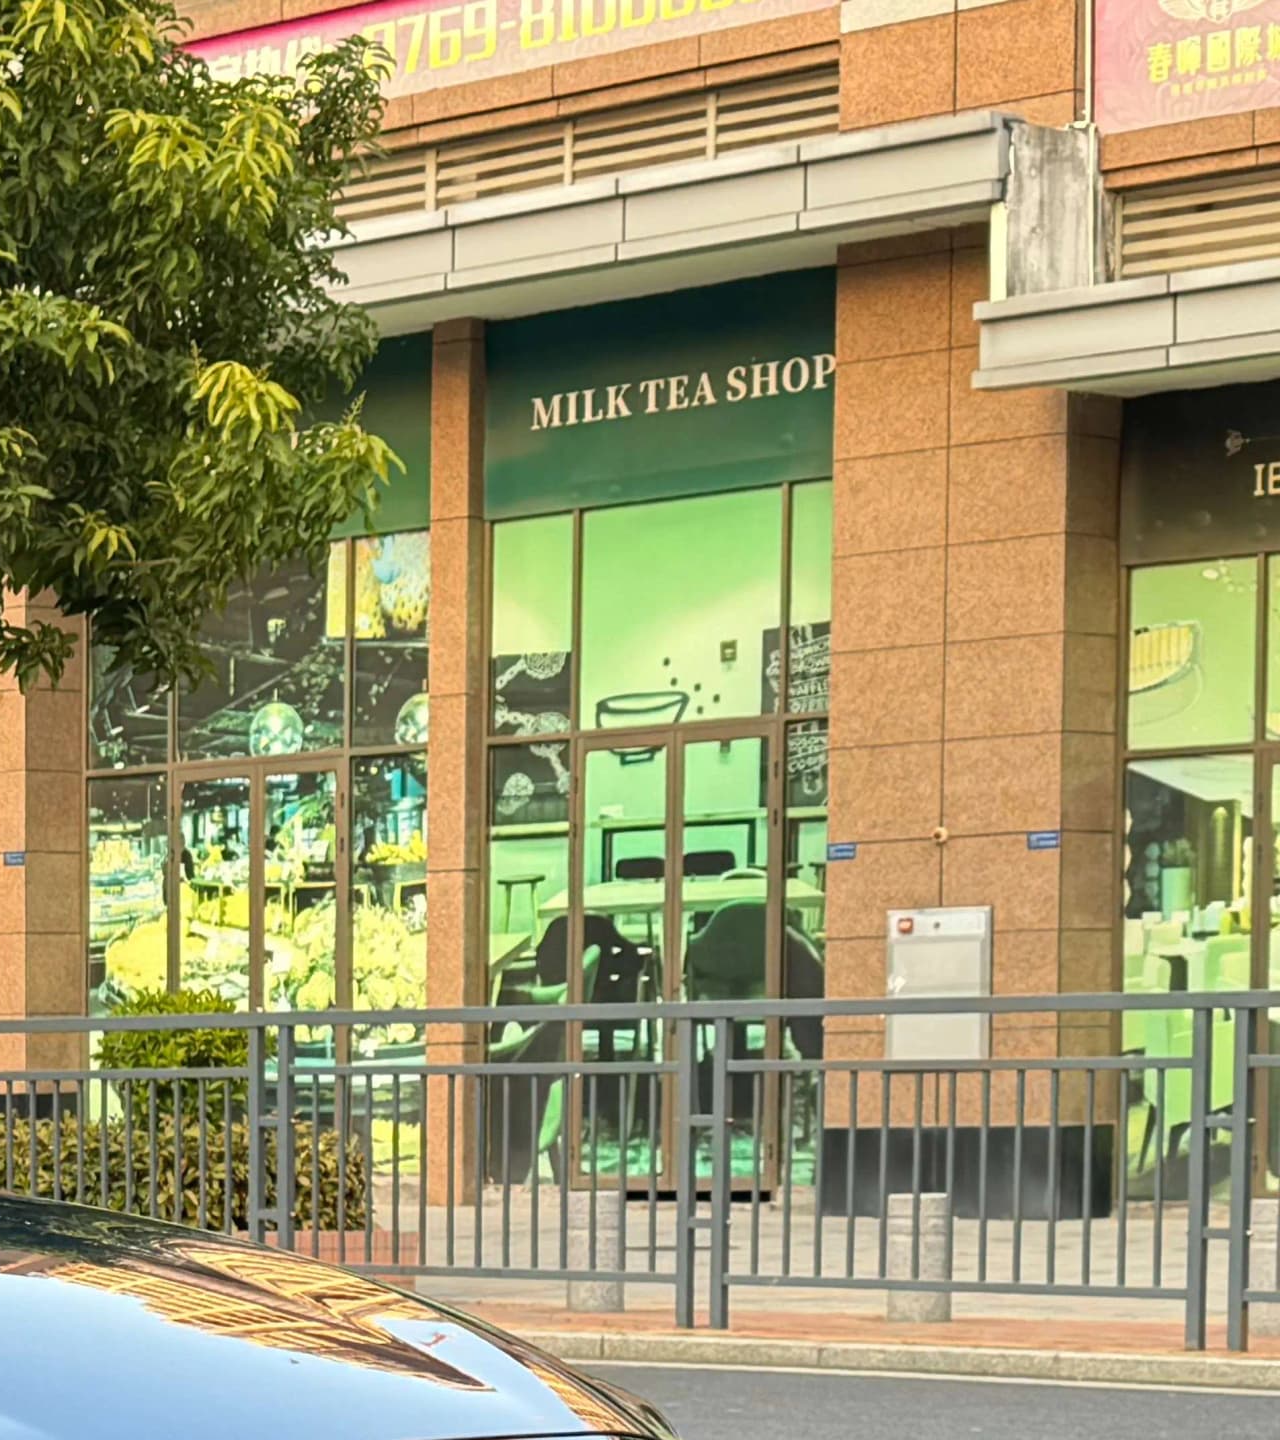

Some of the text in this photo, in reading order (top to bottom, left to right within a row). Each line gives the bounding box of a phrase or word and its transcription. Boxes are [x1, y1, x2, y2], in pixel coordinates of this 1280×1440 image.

[531, 353, 837, 430] MILK TEA SHOP
